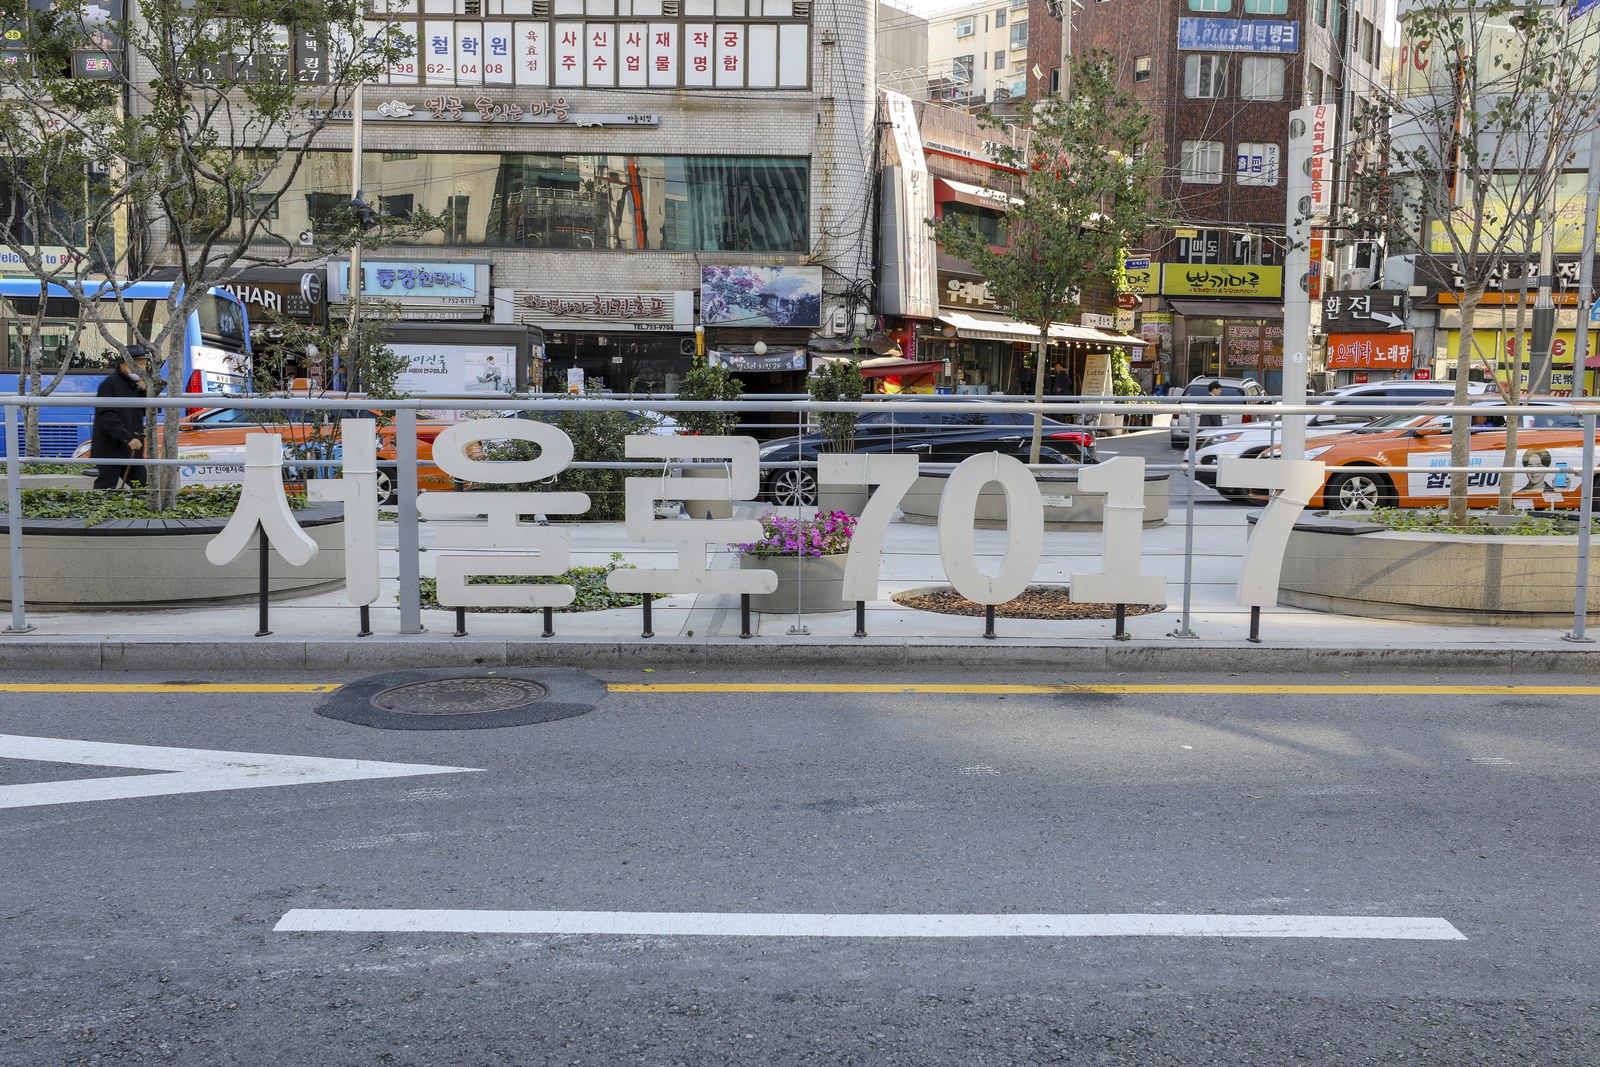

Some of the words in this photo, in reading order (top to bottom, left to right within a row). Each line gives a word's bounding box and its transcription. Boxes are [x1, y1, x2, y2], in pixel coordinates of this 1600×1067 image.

[424, 96, 464, 122] 옛골
[474, 95, 523, 123] 술익는
[530, 96, 569, 122] 마을
[205, 418, 779, 607] 서울로
[817, 451, 1326, 607] 7017
